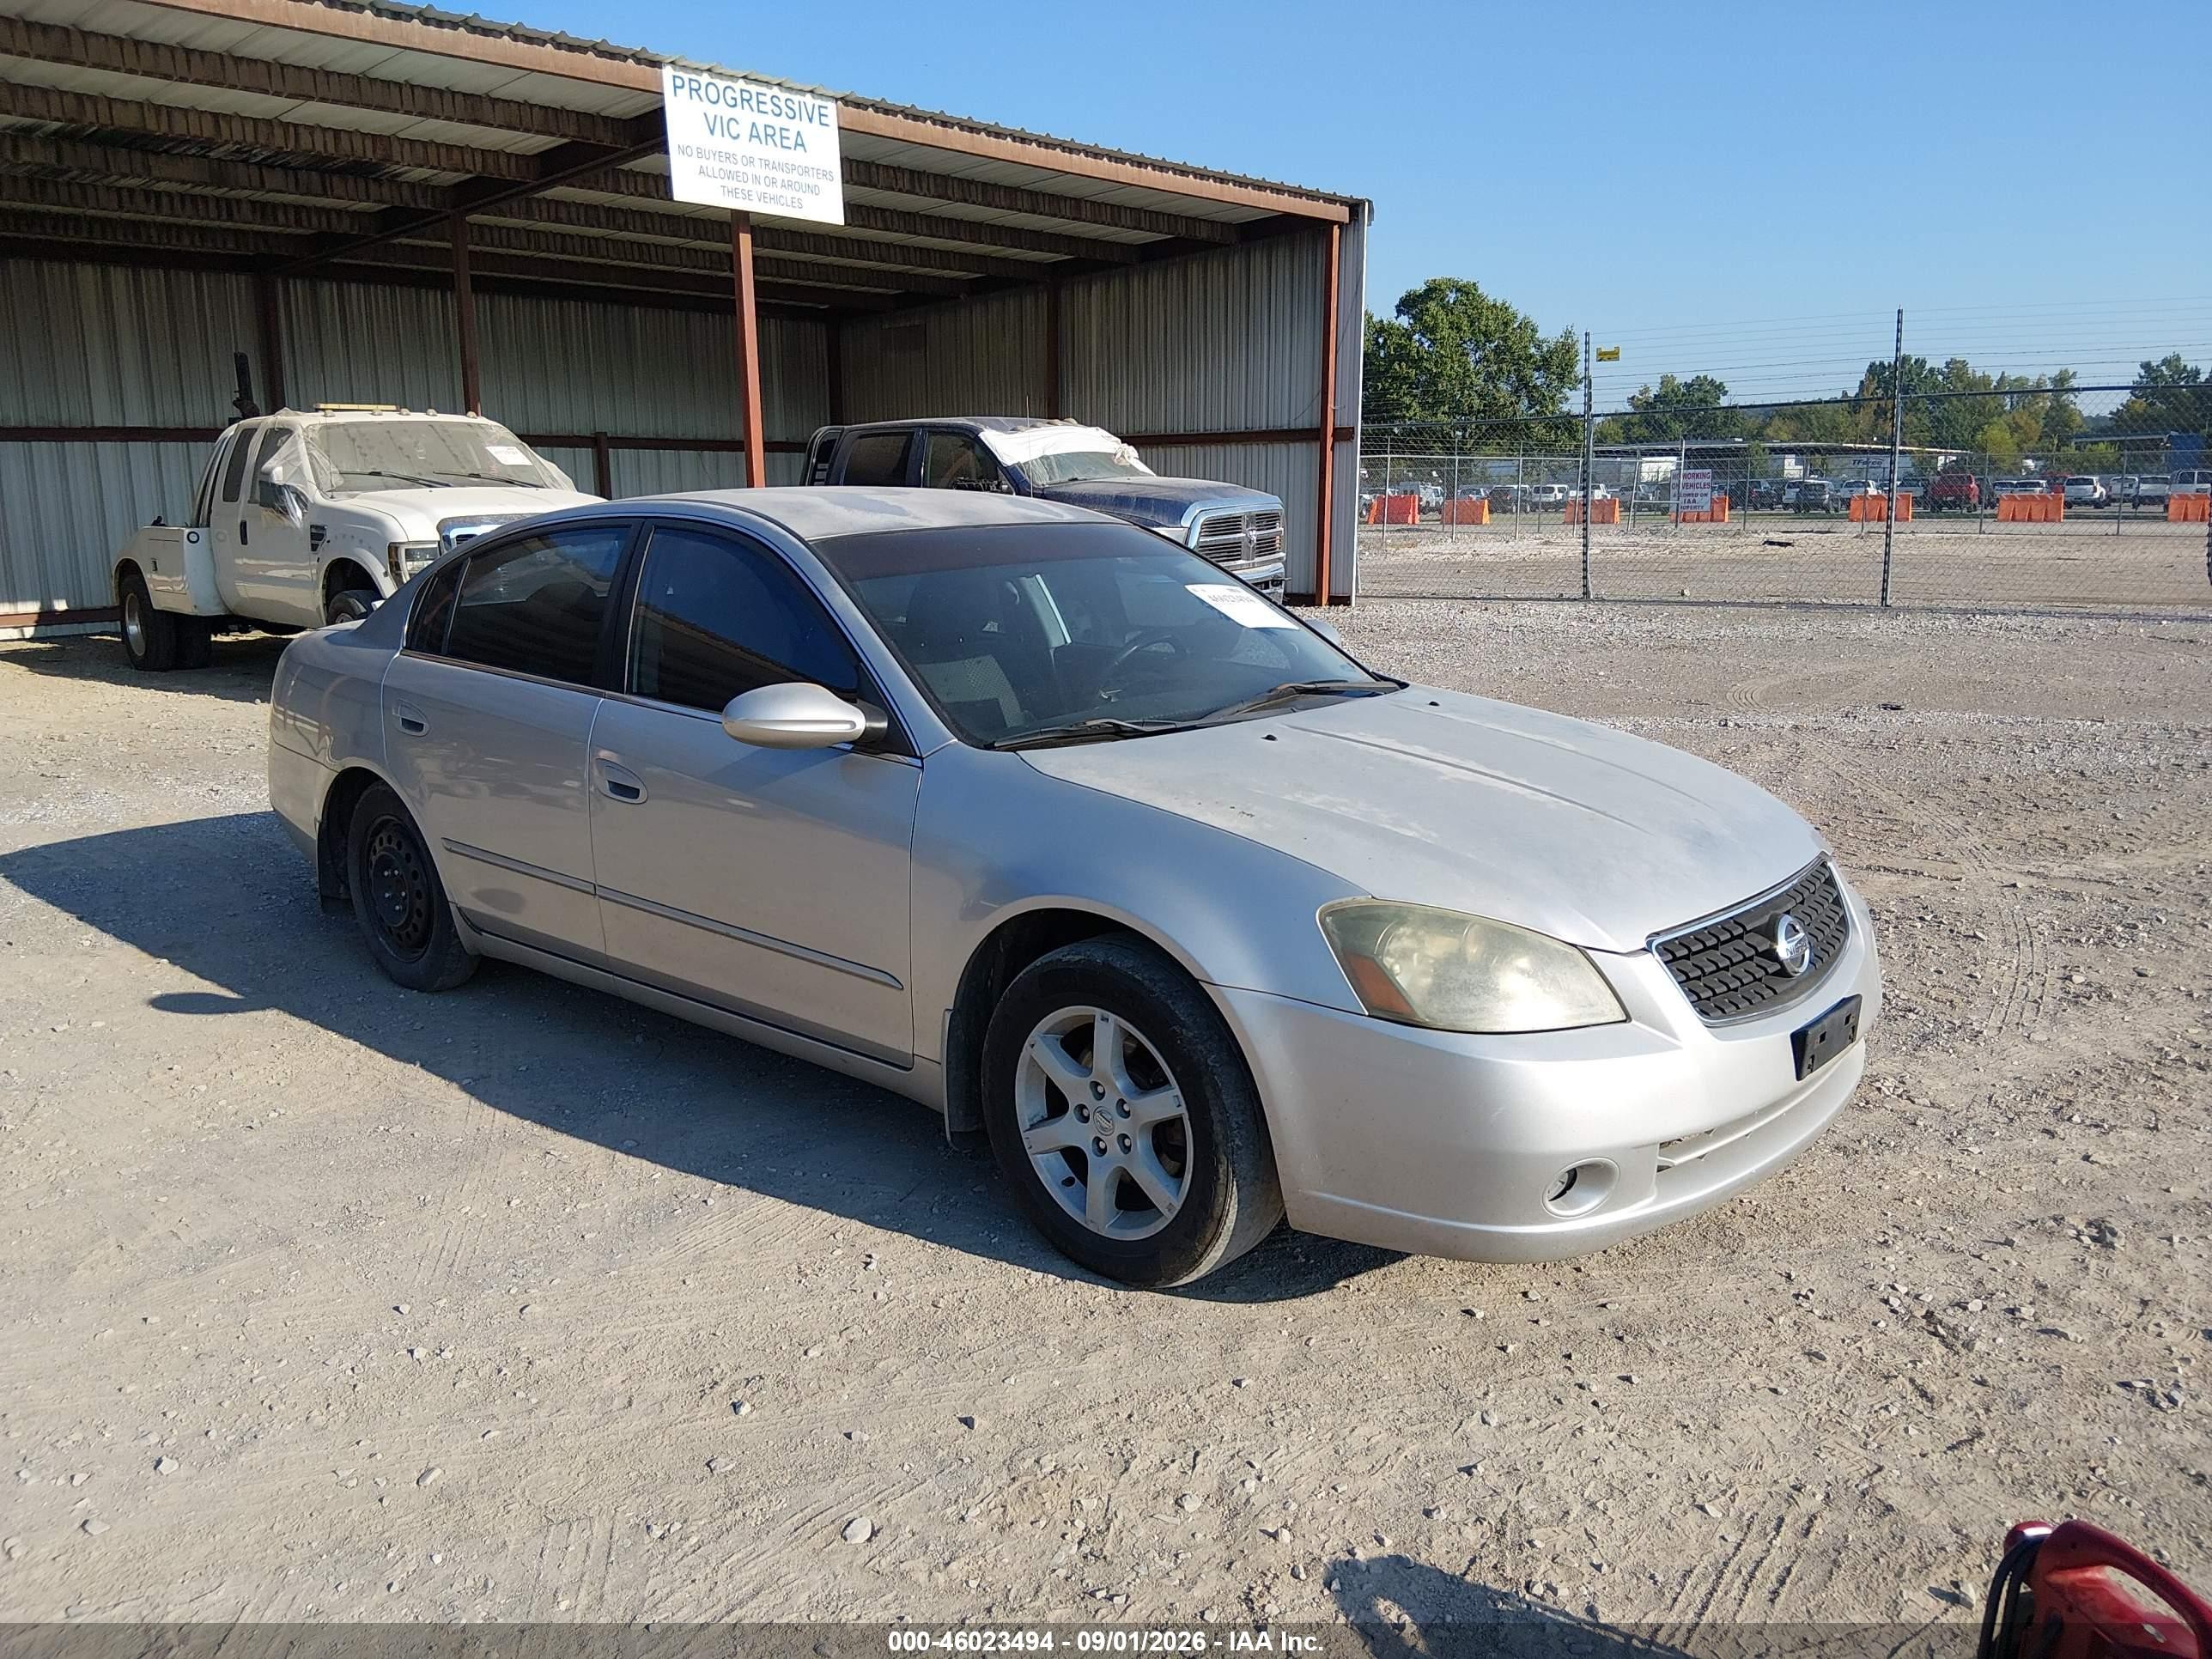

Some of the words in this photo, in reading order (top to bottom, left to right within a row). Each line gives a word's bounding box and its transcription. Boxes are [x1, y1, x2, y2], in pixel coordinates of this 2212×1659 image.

[672, 75, 830, 127] PROGRESSIVE
[703, 112, 741, 141] VIC
[748, 122, 807, 153] AREA
[678, 144, 693, 157] NO
[696, 147, 738, 165] BUYERS
[741, 155, 755, 167] OR
[757, 158, 835, 182] TRANSPORTERS
[698, 165, 749, 184] ALLOWED
[751, 173, 761, 185] IN
[763, 175, 778, 188] OR
[781, 179, 820, 196] AROUND
[720, 185, 754, 201] THESE
[756, 191, 804, 210] VEHICLES
